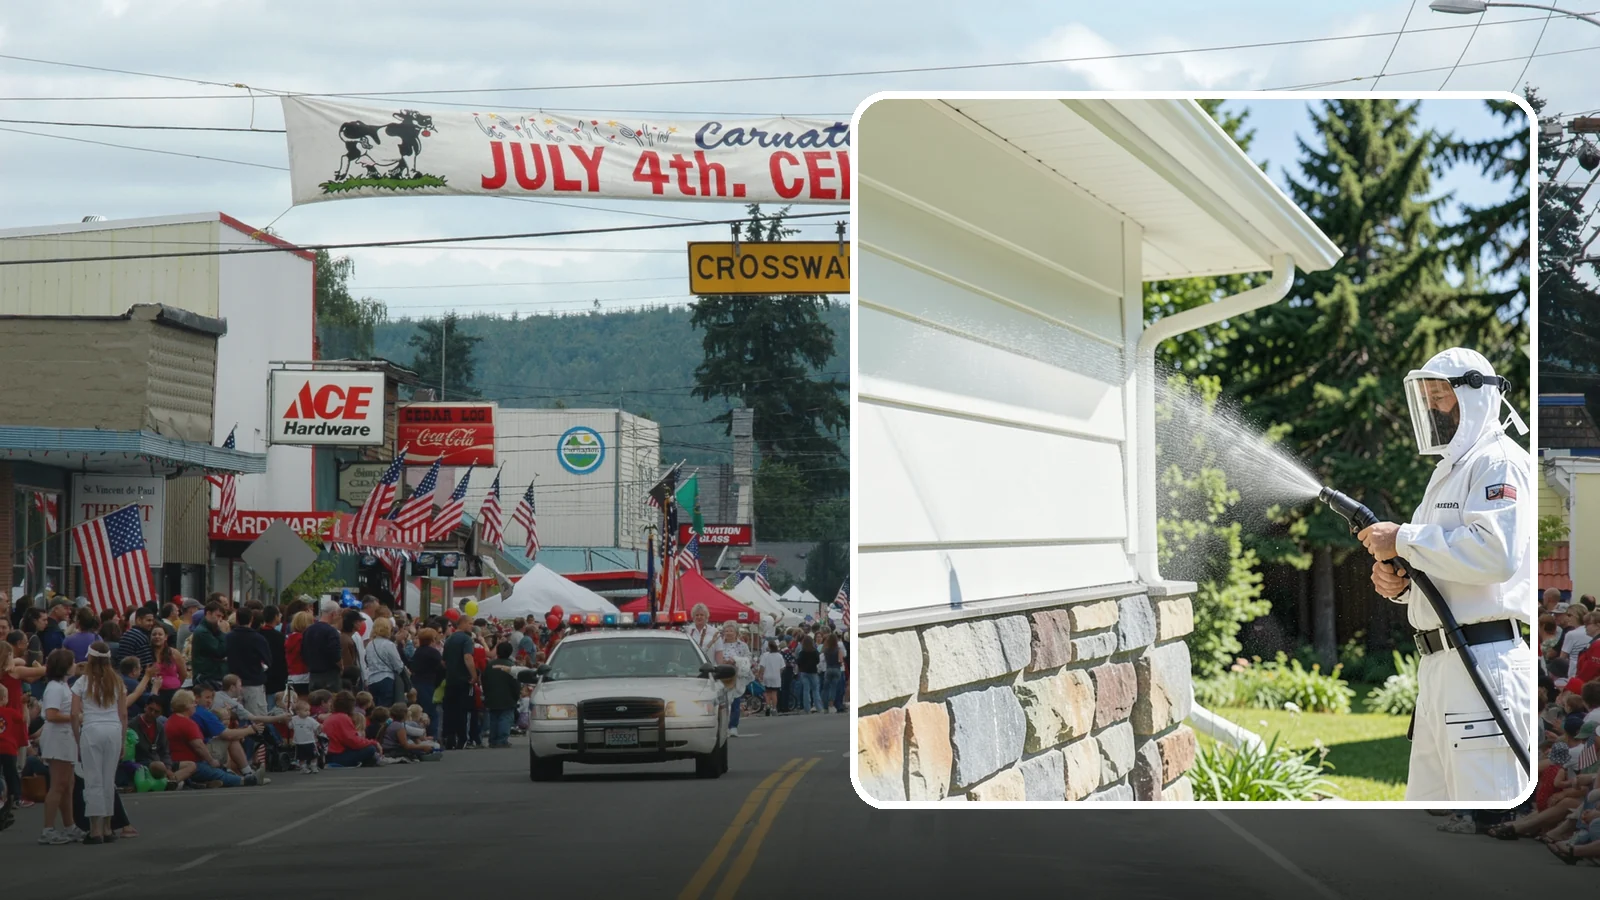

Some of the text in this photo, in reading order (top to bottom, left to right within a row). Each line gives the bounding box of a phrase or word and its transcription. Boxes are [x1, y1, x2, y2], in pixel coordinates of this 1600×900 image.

[694, 121, 850, 150] Carnat
[481, 140, 605, 193] JULY
[632, 150, 746, 198] 4th.
[697, 254, 850, 280] CROSSWA
[283, 380, 373, 419] ACE
[406, 409, 485, 421] CEDAR LOG
[283, 421, 371, 436] Hardware
[416, 428, 477, 447] Coca-Cola
[353, 467, 385, 480] Simpl
[95, 485, 124, 494] Vincent
[126, 486, 136, 494] de
[138, 486, 155, 495] Paul
